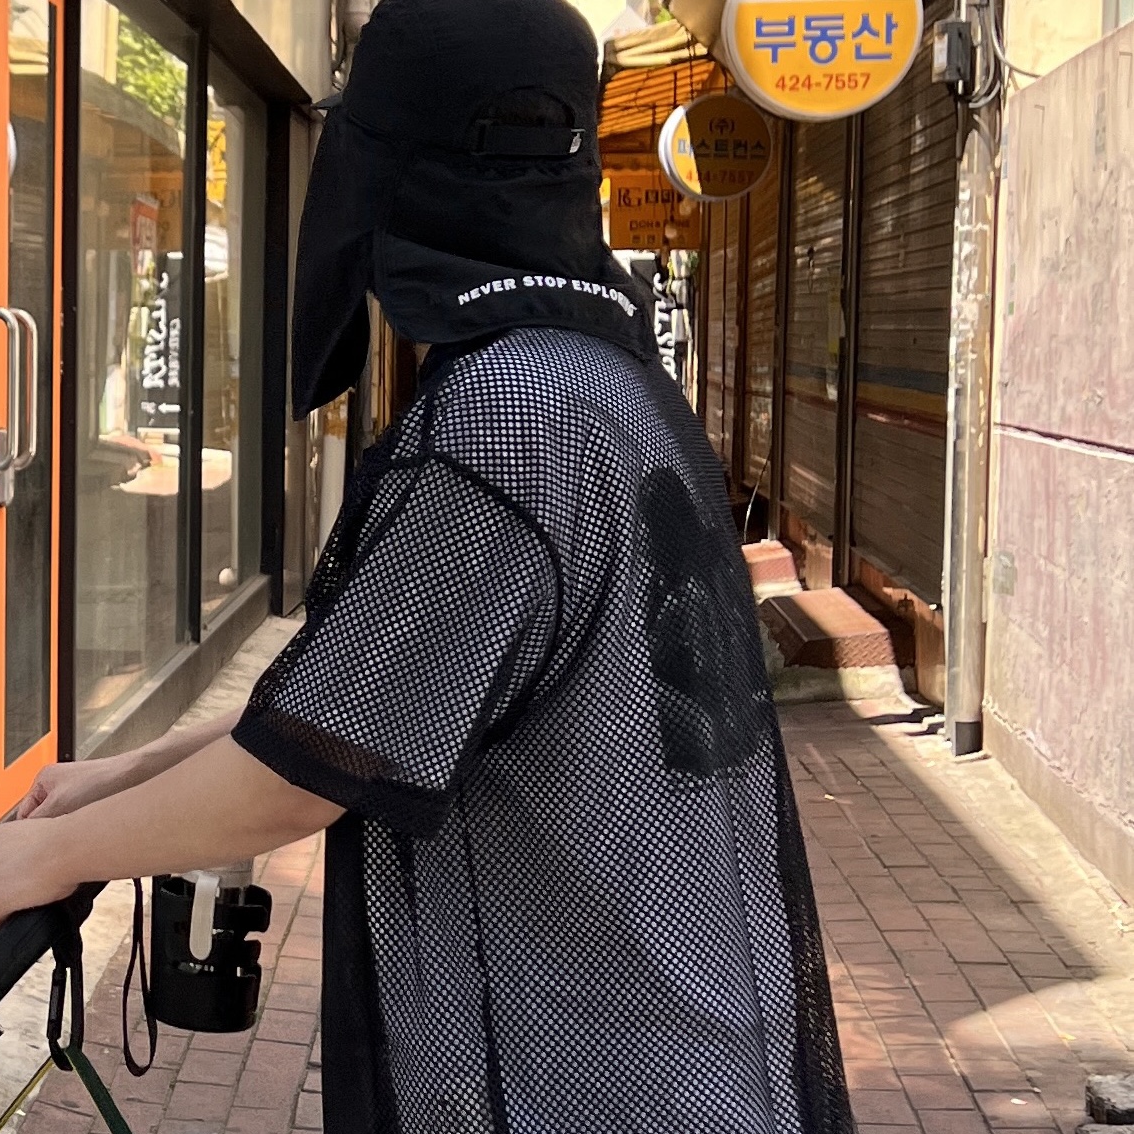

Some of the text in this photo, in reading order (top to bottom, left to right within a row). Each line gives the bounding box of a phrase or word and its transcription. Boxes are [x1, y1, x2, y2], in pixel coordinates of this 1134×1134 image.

[753, 12, 899, 65] 부동산
[774, 72, 872, 92] 424-7557
[457, 277, 517, 306] NEVER
[522, 275, 567, 289] STOP
